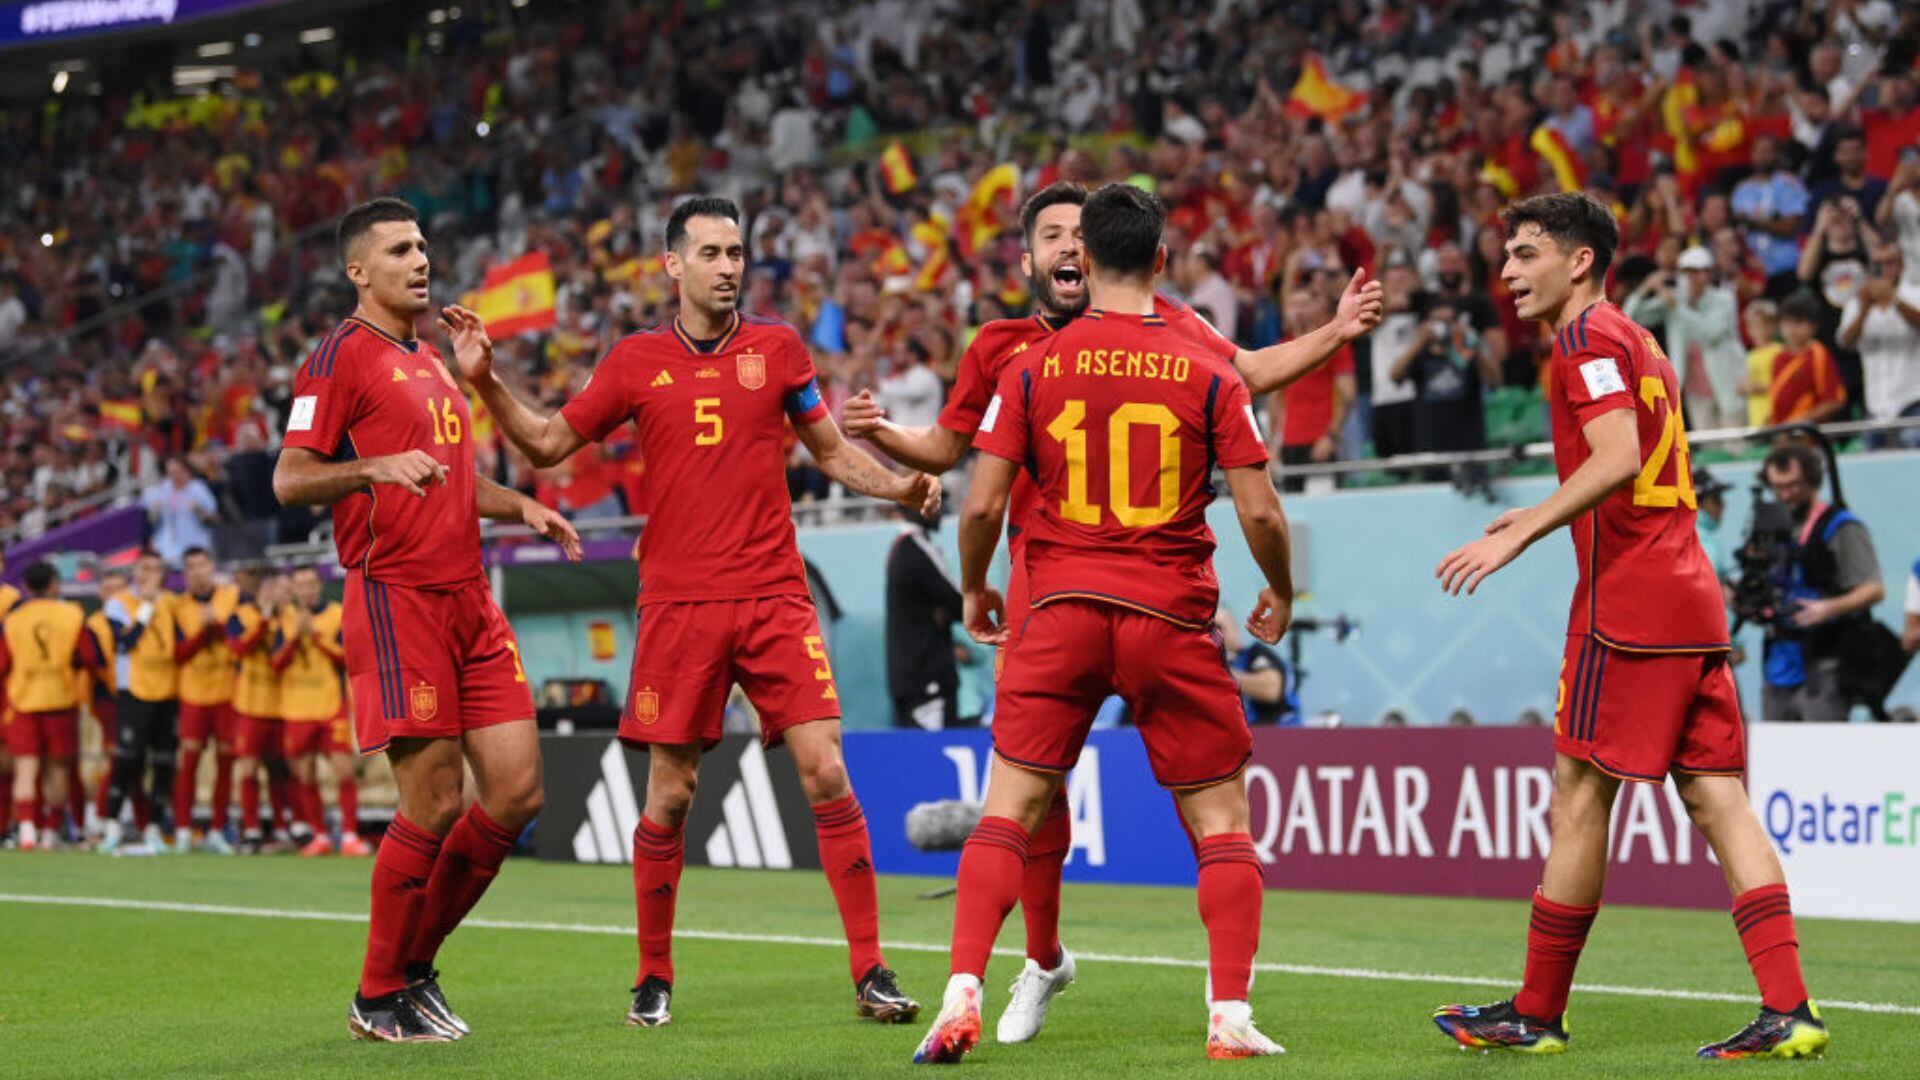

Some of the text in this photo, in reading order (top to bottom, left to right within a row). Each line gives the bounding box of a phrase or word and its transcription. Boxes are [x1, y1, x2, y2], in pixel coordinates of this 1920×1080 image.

[1076, 350, 1189, 382] ASENSIO
[428, 397, 462, 445] 16
[694, 398, 723, 445] 5
[1046, 400, 1181, 528] 10
[804, 635, 832, 680] 5
[942, 746, 1105, 866] VA
[1245, 765, 1721, 866] QATAR AIRAY
